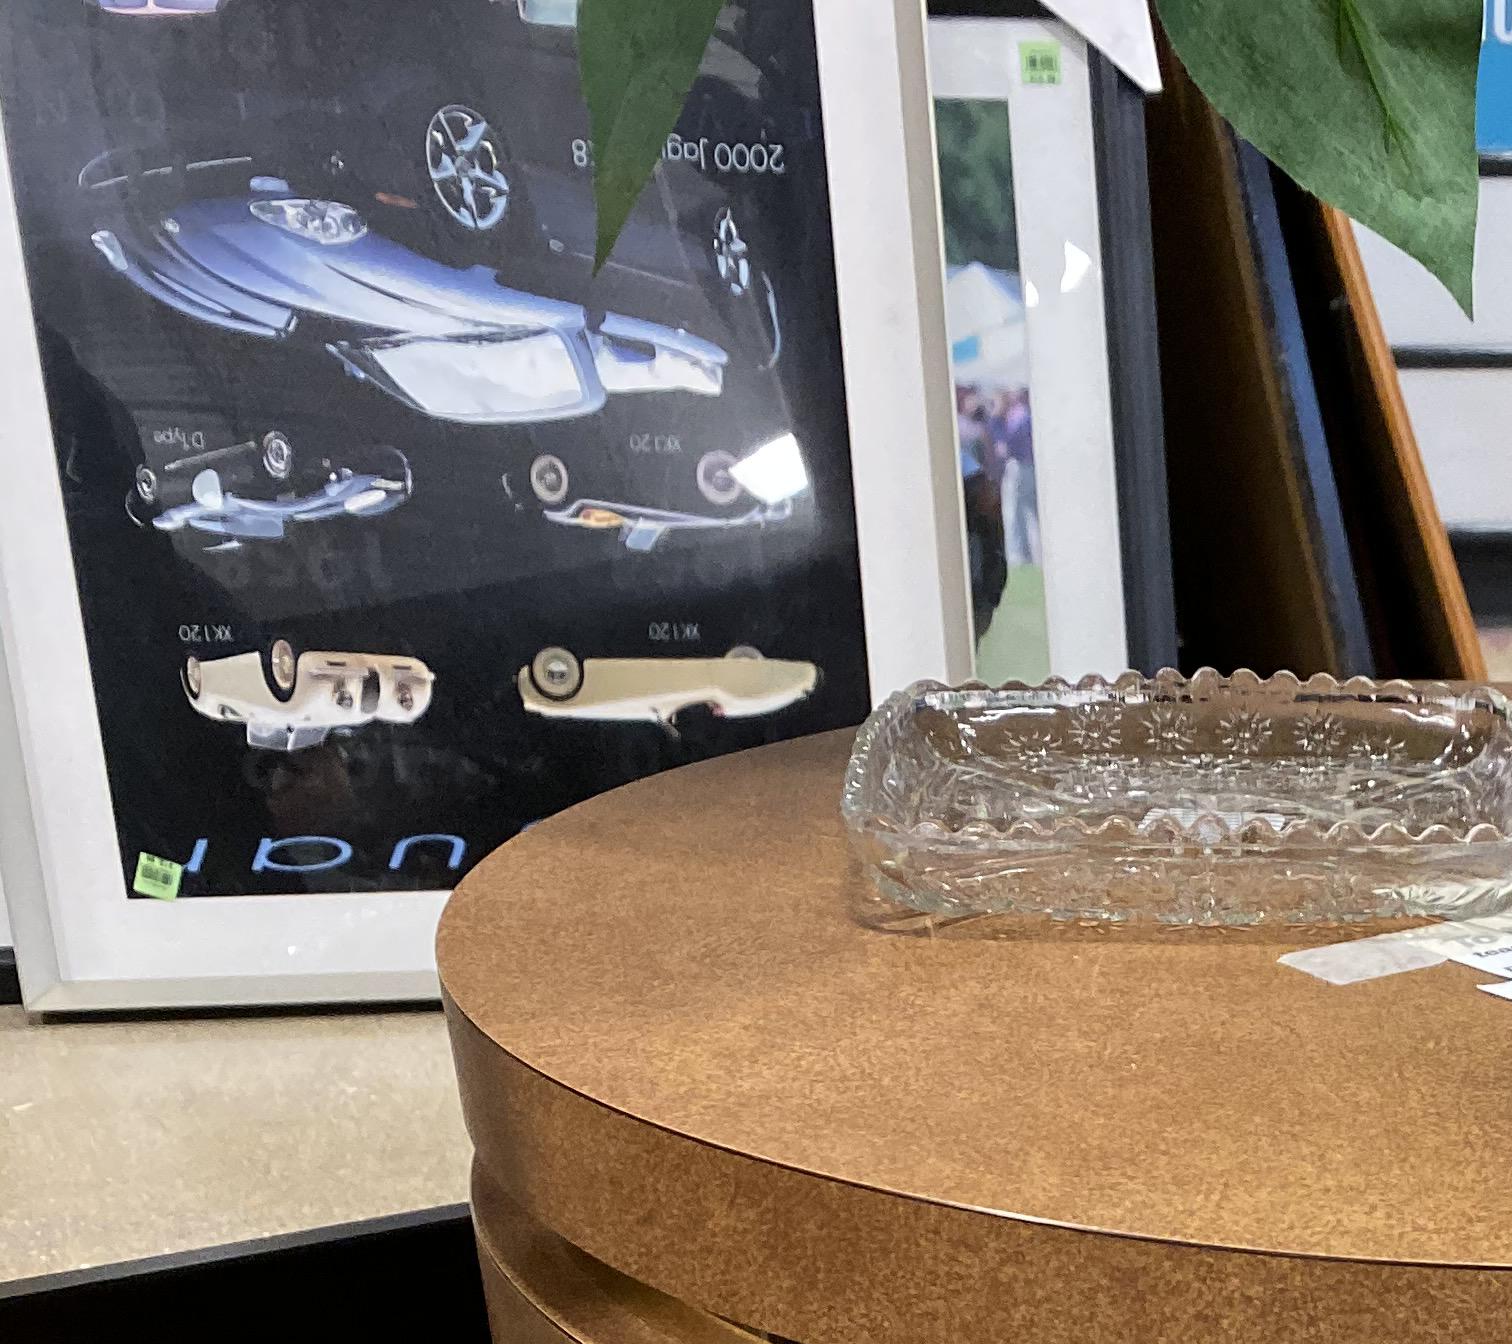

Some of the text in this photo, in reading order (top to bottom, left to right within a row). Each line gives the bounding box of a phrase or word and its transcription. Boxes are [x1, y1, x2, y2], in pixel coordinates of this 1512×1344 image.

[661, 132, 785, 174] 2000 Jag
[178, 624, 233, 642] XK120
